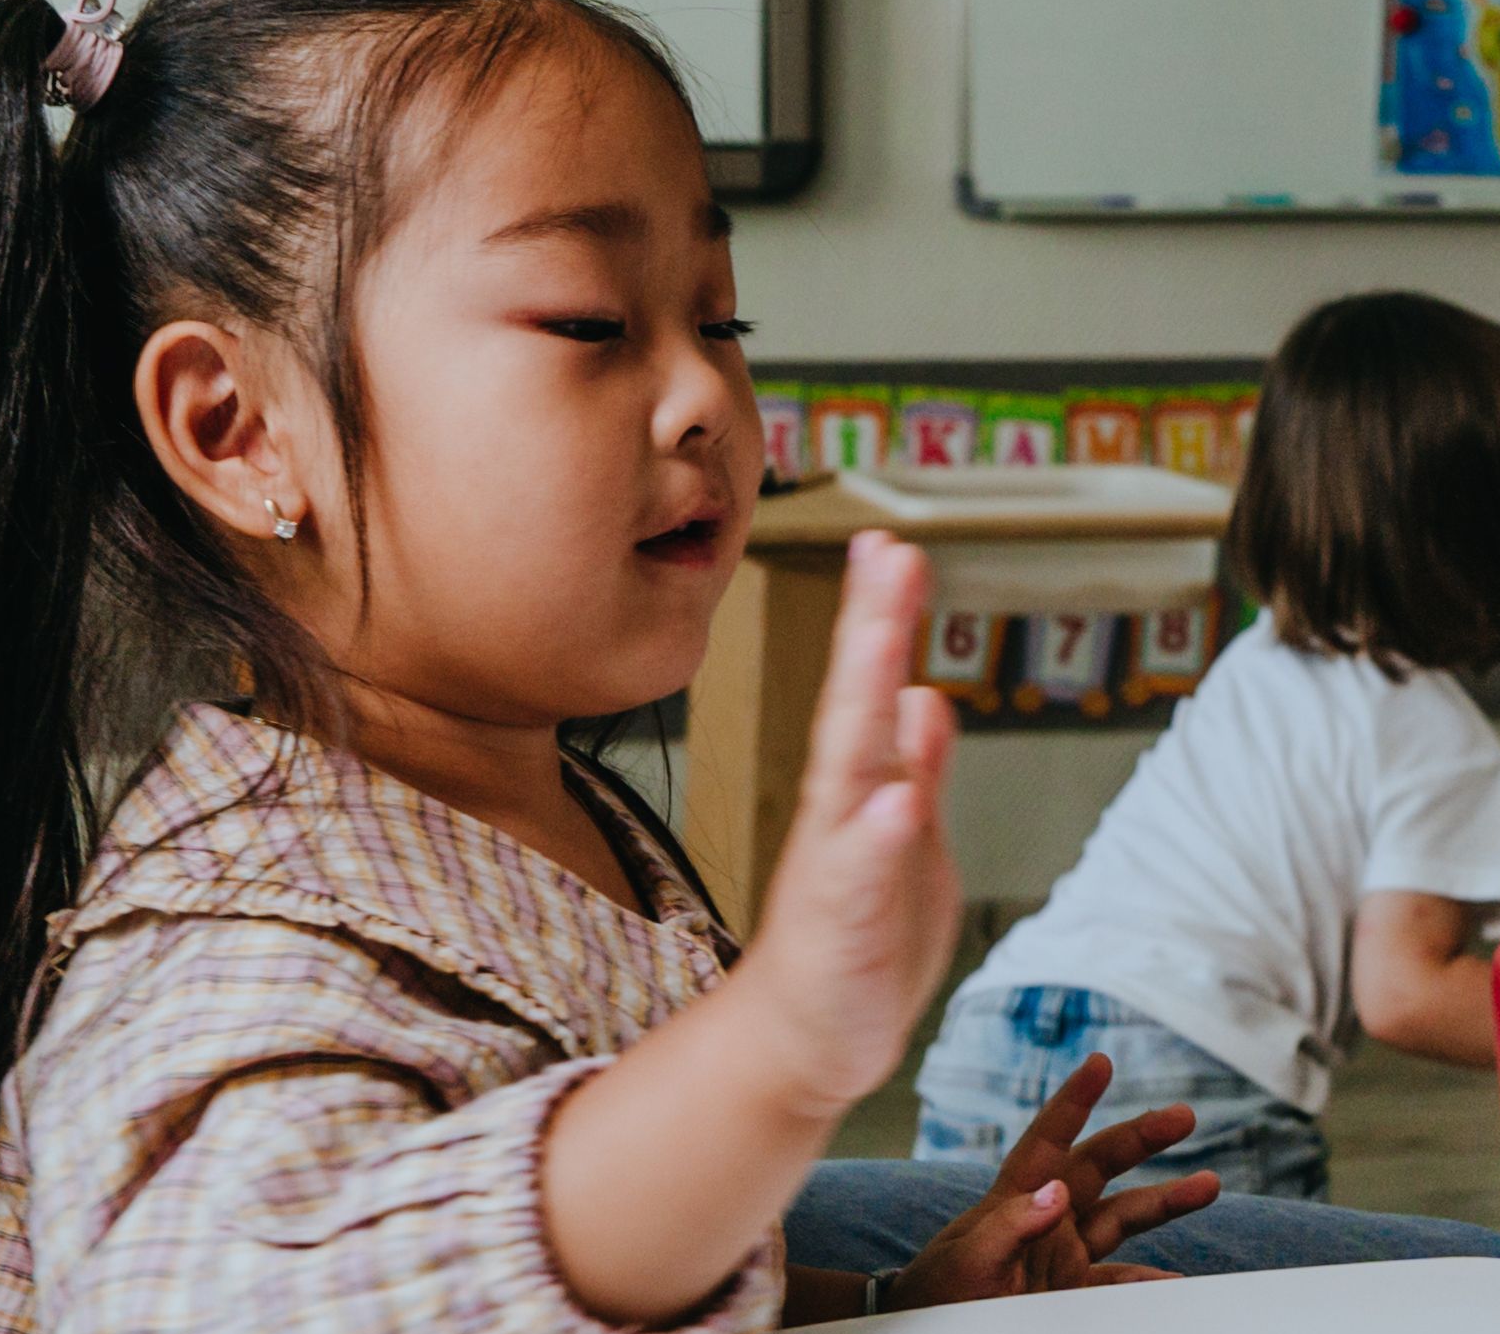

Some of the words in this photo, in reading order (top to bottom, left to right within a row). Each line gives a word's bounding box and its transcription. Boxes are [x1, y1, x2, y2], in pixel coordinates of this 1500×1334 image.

[945, 609, 977, 659] 6
[1056, 613, 1087, 667] 7
[1157, 607, 1190, 654] 8
